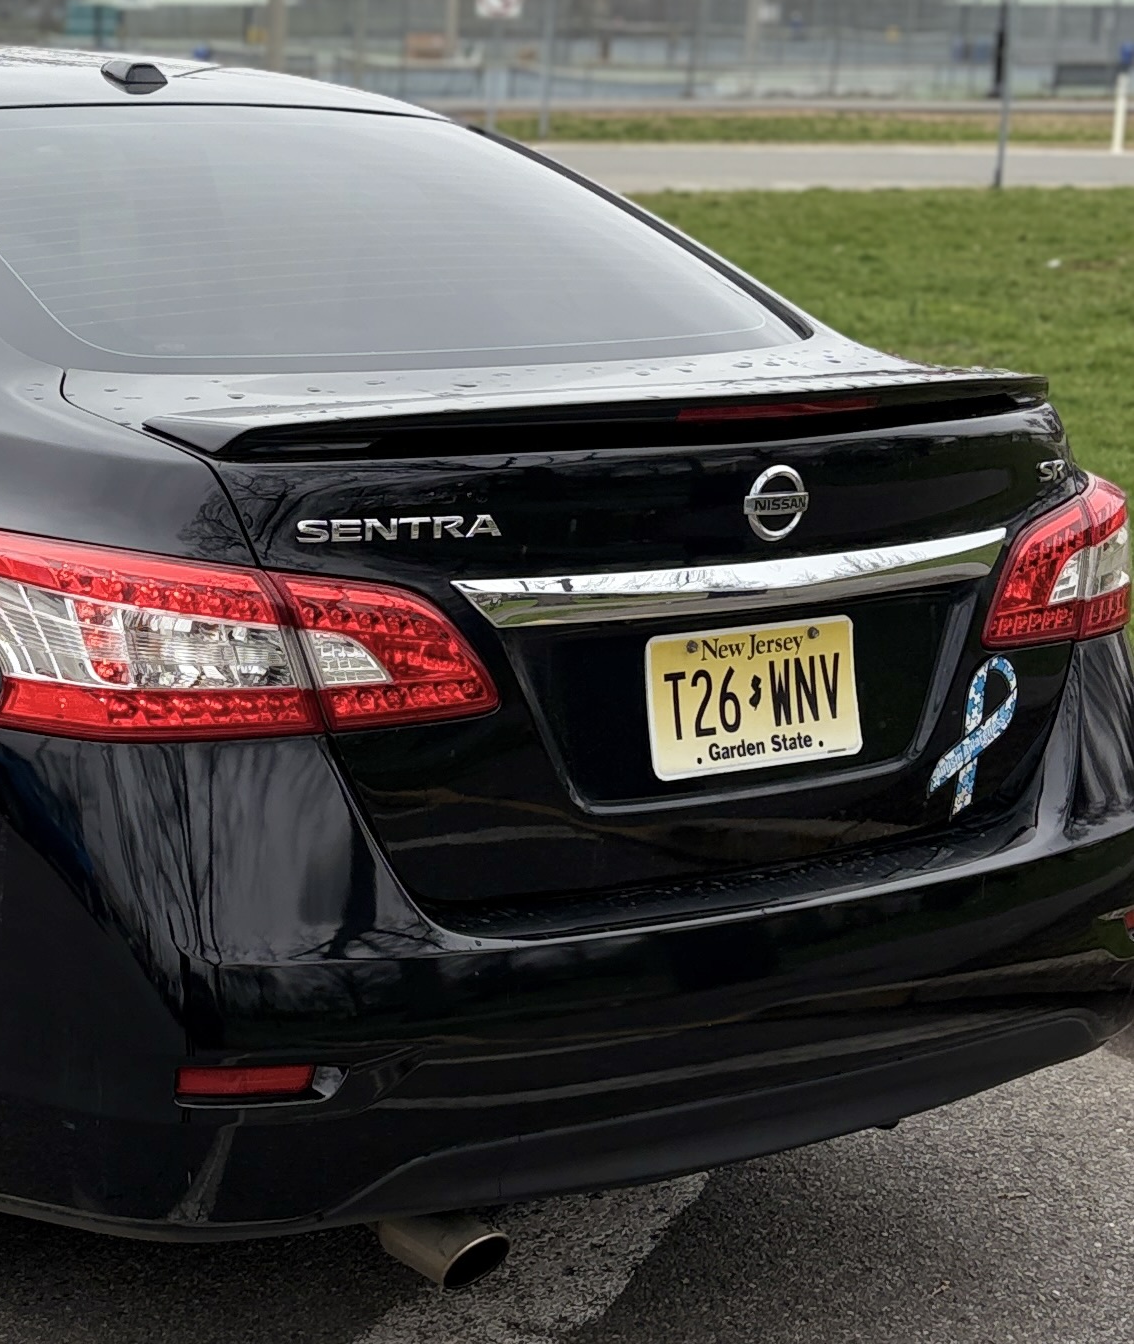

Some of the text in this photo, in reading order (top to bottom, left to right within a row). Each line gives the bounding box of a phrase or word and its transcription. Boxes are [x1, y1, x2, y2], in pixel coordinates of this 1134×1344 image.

[1038, 459, 1065, 483] SR
[753, 496, 806, 512] NISSAN
[296, 514, 502, 544] SENTRA
[700, 634, 804, 661] New Jersey
[663, 652, 840, 741] T26 WNV
[708, 732, 813, 762] Garden State
